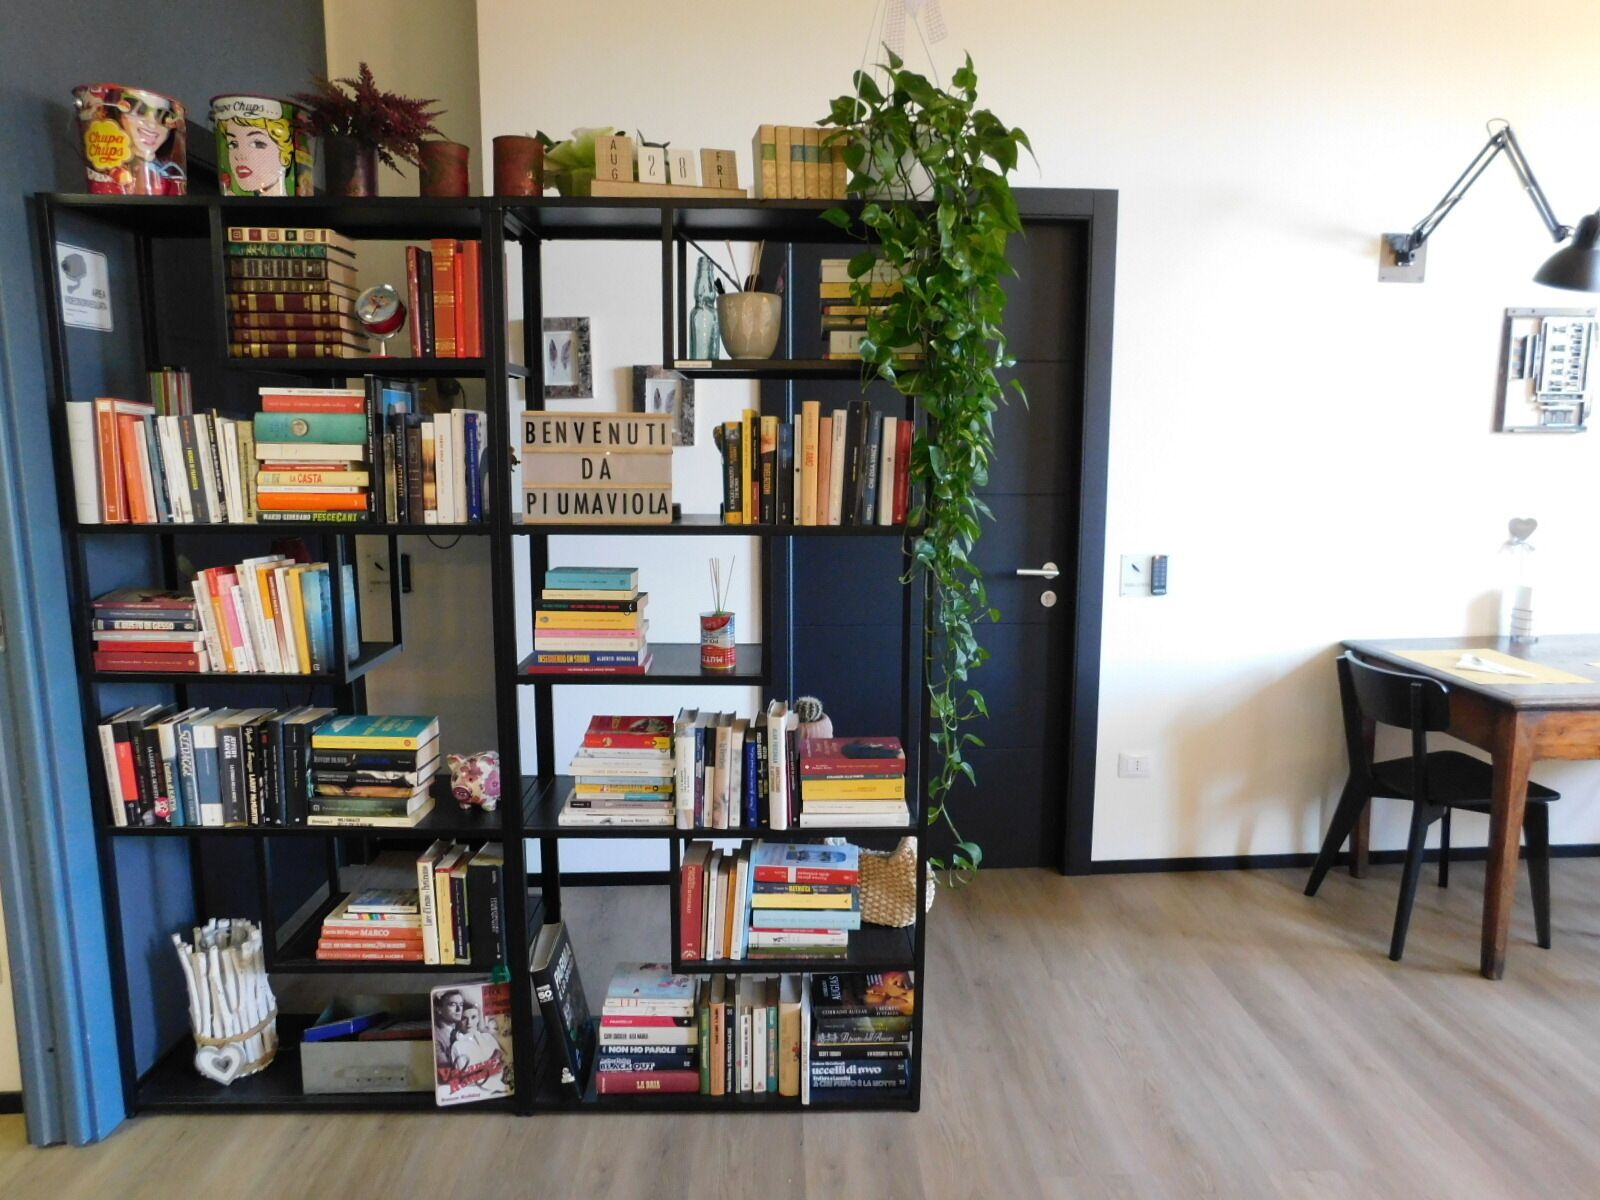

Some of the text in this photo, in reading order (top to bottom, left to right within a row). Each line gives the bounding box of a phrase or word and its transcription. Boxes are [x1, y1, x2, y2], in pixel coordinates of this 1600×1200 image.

[89, 131, 124, 145] Chupa
[88, 144, 124, 162] Chups
[610, 139, 619, 180] AUG
[716, 151, 724, 189] FRI
[526, 421, 666, 445] BENVENUTI
[582, 457, 611, 480] DA
[297, 473, 322, 483] CASTA
[527, 492, 668, 515] PIUMAVIOLA
[312, 511, 357, 522] PESCECANI
[360, 928, 390, 937] MARCO
[829, 975, 841, 1000] AUGIAS
[608, 1045, 677, 1054] NON HO PAROLE
[600, 1062, 655, 1072] BLACK OUT
[812, 1064, 845, 1075] uccelli
[845, 1064, 856, 1075] di
[636, 1080, 645, 1089] LA
[863, 1079, 872, 1087] LA
